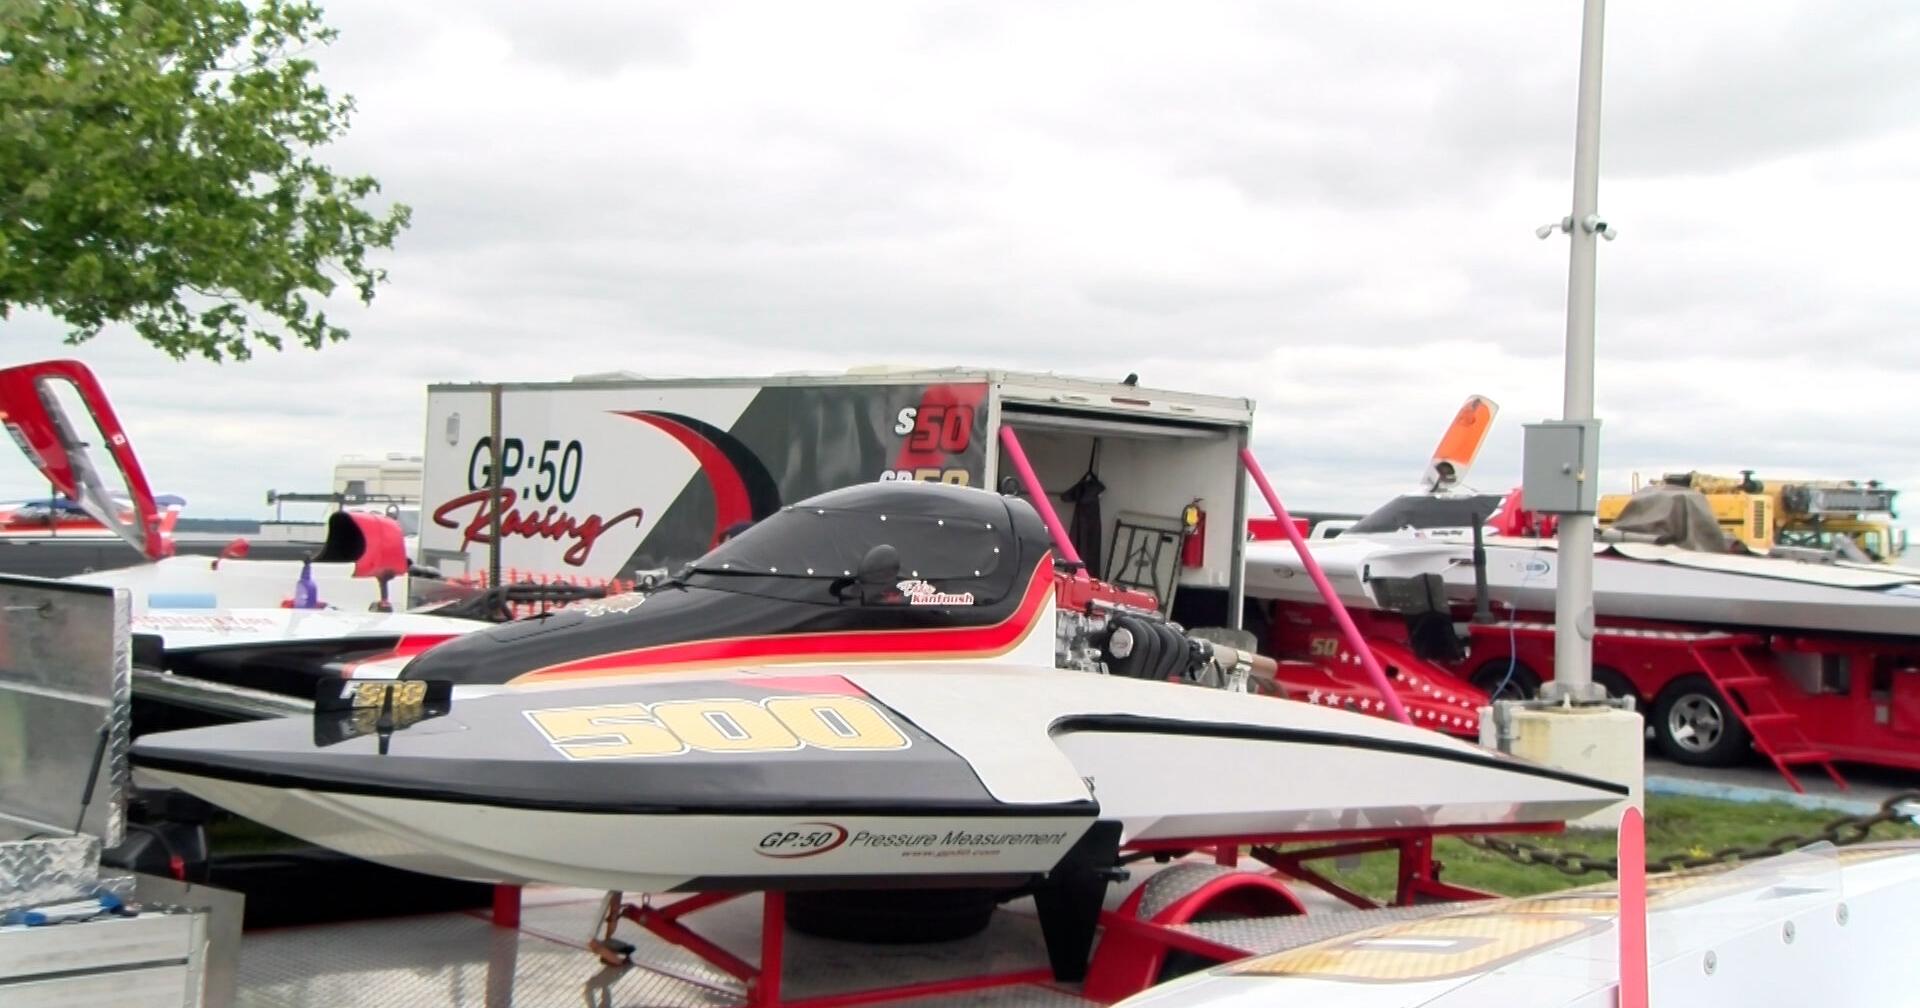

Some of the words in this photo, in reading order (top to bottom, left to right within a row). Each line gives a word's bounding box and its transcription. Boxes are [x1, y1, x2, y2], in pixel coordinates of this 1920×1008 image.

[894, 405, 974, 454] S50
[468, 436, 583, 503] GP:50
[433, 488, 643, 566] Racing
[522, 696, 912, 761] 500
[759, 832, 833, 848] GP:50
[849, 830, 937, 847] Pressure
[940, 830, 1067, 846] Measurement
